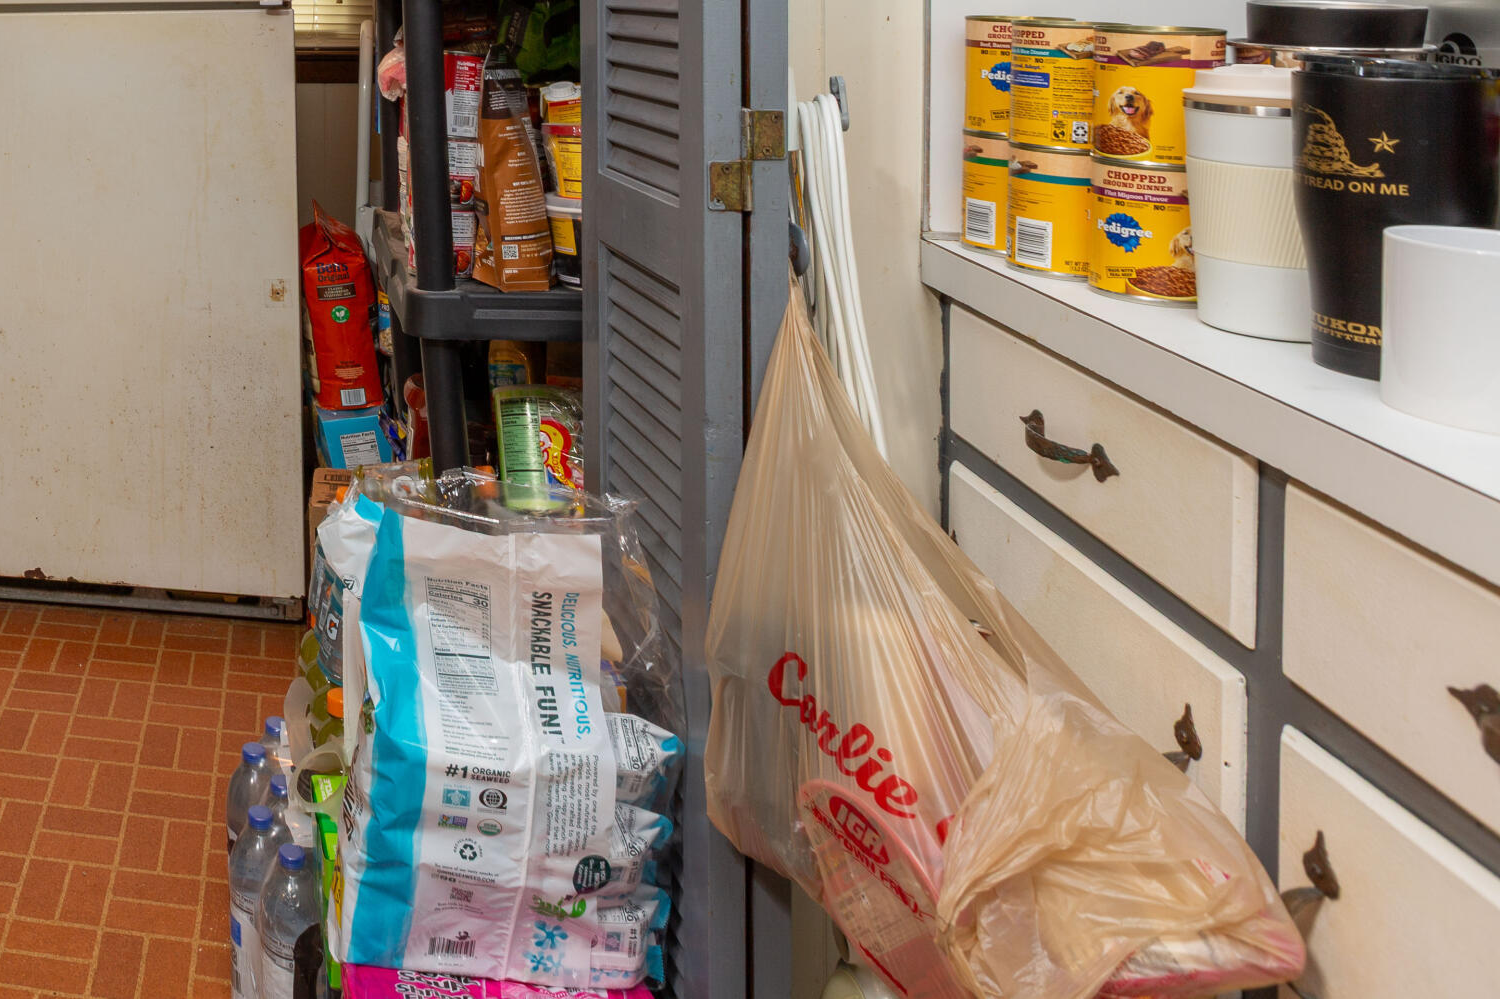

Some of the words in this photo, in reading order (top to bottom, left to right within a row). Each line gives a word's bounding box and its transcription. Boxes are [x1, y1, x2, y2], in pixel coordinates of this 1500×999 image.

[1102, 179, 1135, 189] GROUND
[1136, 183, 1173, 193] DINNER
[1107, 169, 1167, 185] CHOPPED
[1303, 175, 1344, 192] TREAD
[1348, 181, 1375, 195] ON
[1379, 182, 1410, 197] ME
[1118, 190, 1143, 201] Mignon
[1144, 193, 1169, 203] Flavor
[1097, 218, 1153, 239] Pedigree
[316, 262, 349, 275] Ben's
[317, 271, 350, 283] Original
[428, 590, 463, 601] Calories
[473, 598, 489, 608] 30
[560, 592, 580, 650] DELICIOUS,
[530, 590, 553, 677] SNACKABLE
[565, 652, 591, 739] NUTRITIOUS,
[536, 685, 562, 736] FUN!
[768, 651, 919, 820] Carlie
[444, 763, 469, 779] #1
[471, 766, 511, 778] ORGANIC
[591, 755, 599, 787] Powered
[630, 755, 640, 769] 30
[470, 773, 510, 784] SEAWEED
[591, 788, 598, 797] by
[568, 803, 576, 827] crafted
[591, 815, 598, 823] of
[835, 803, 882, 856] IGA
